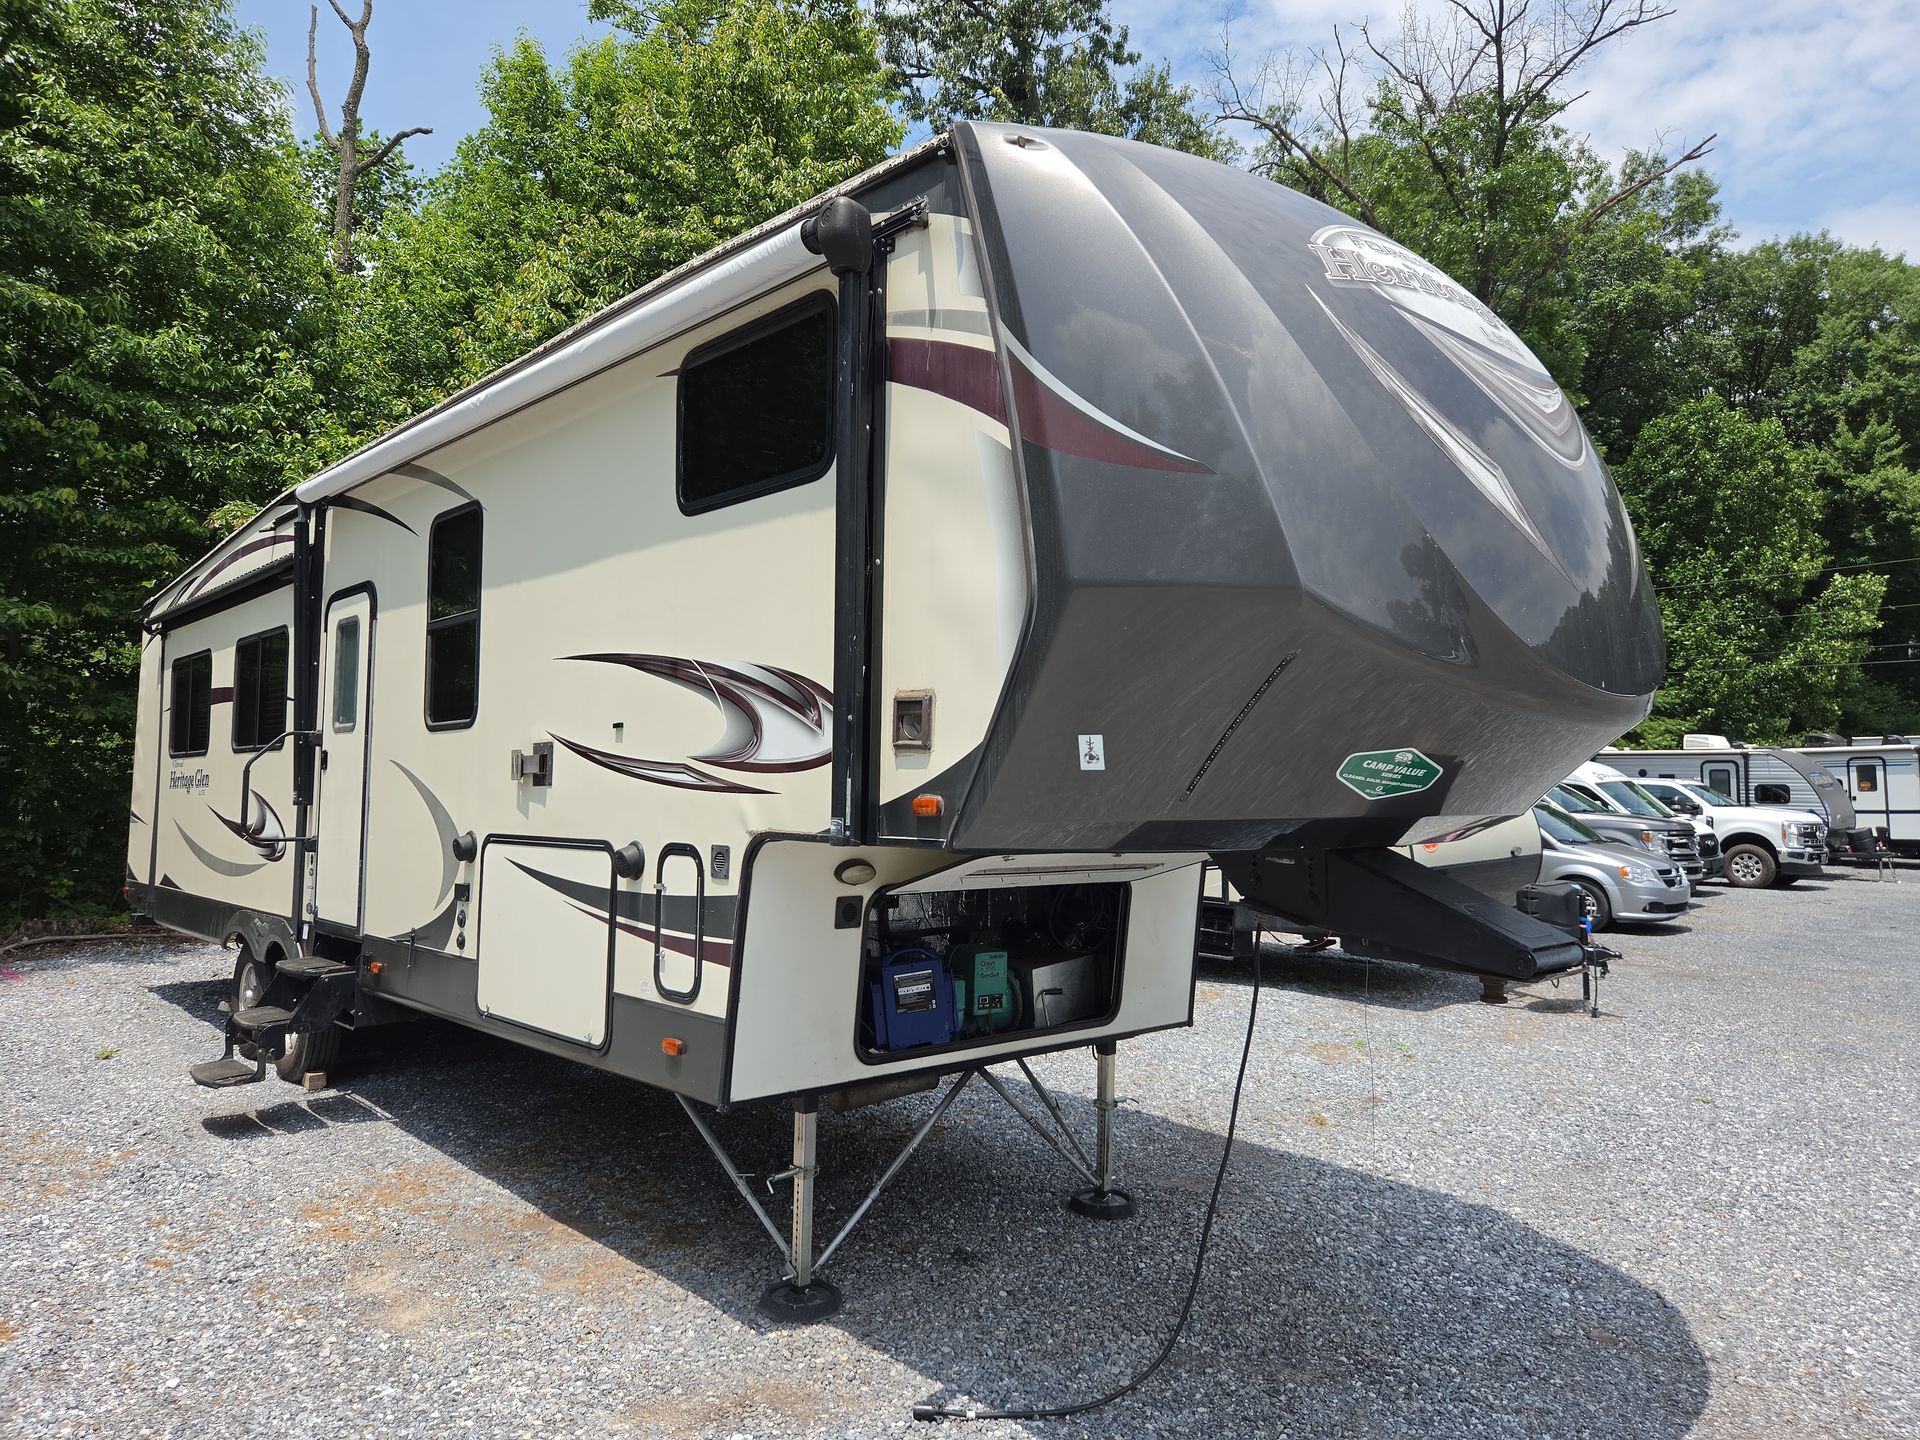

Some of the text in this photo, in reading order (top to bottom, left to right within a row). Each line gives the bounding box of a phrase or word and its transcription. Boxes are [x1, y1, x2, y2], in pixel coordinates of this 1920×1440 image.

[1362, 760, 1427, 777] CAMP VALUE
[1380, 771, 1403, 779] SERIES
[169, 769, 209, 795] Heritage Glen
